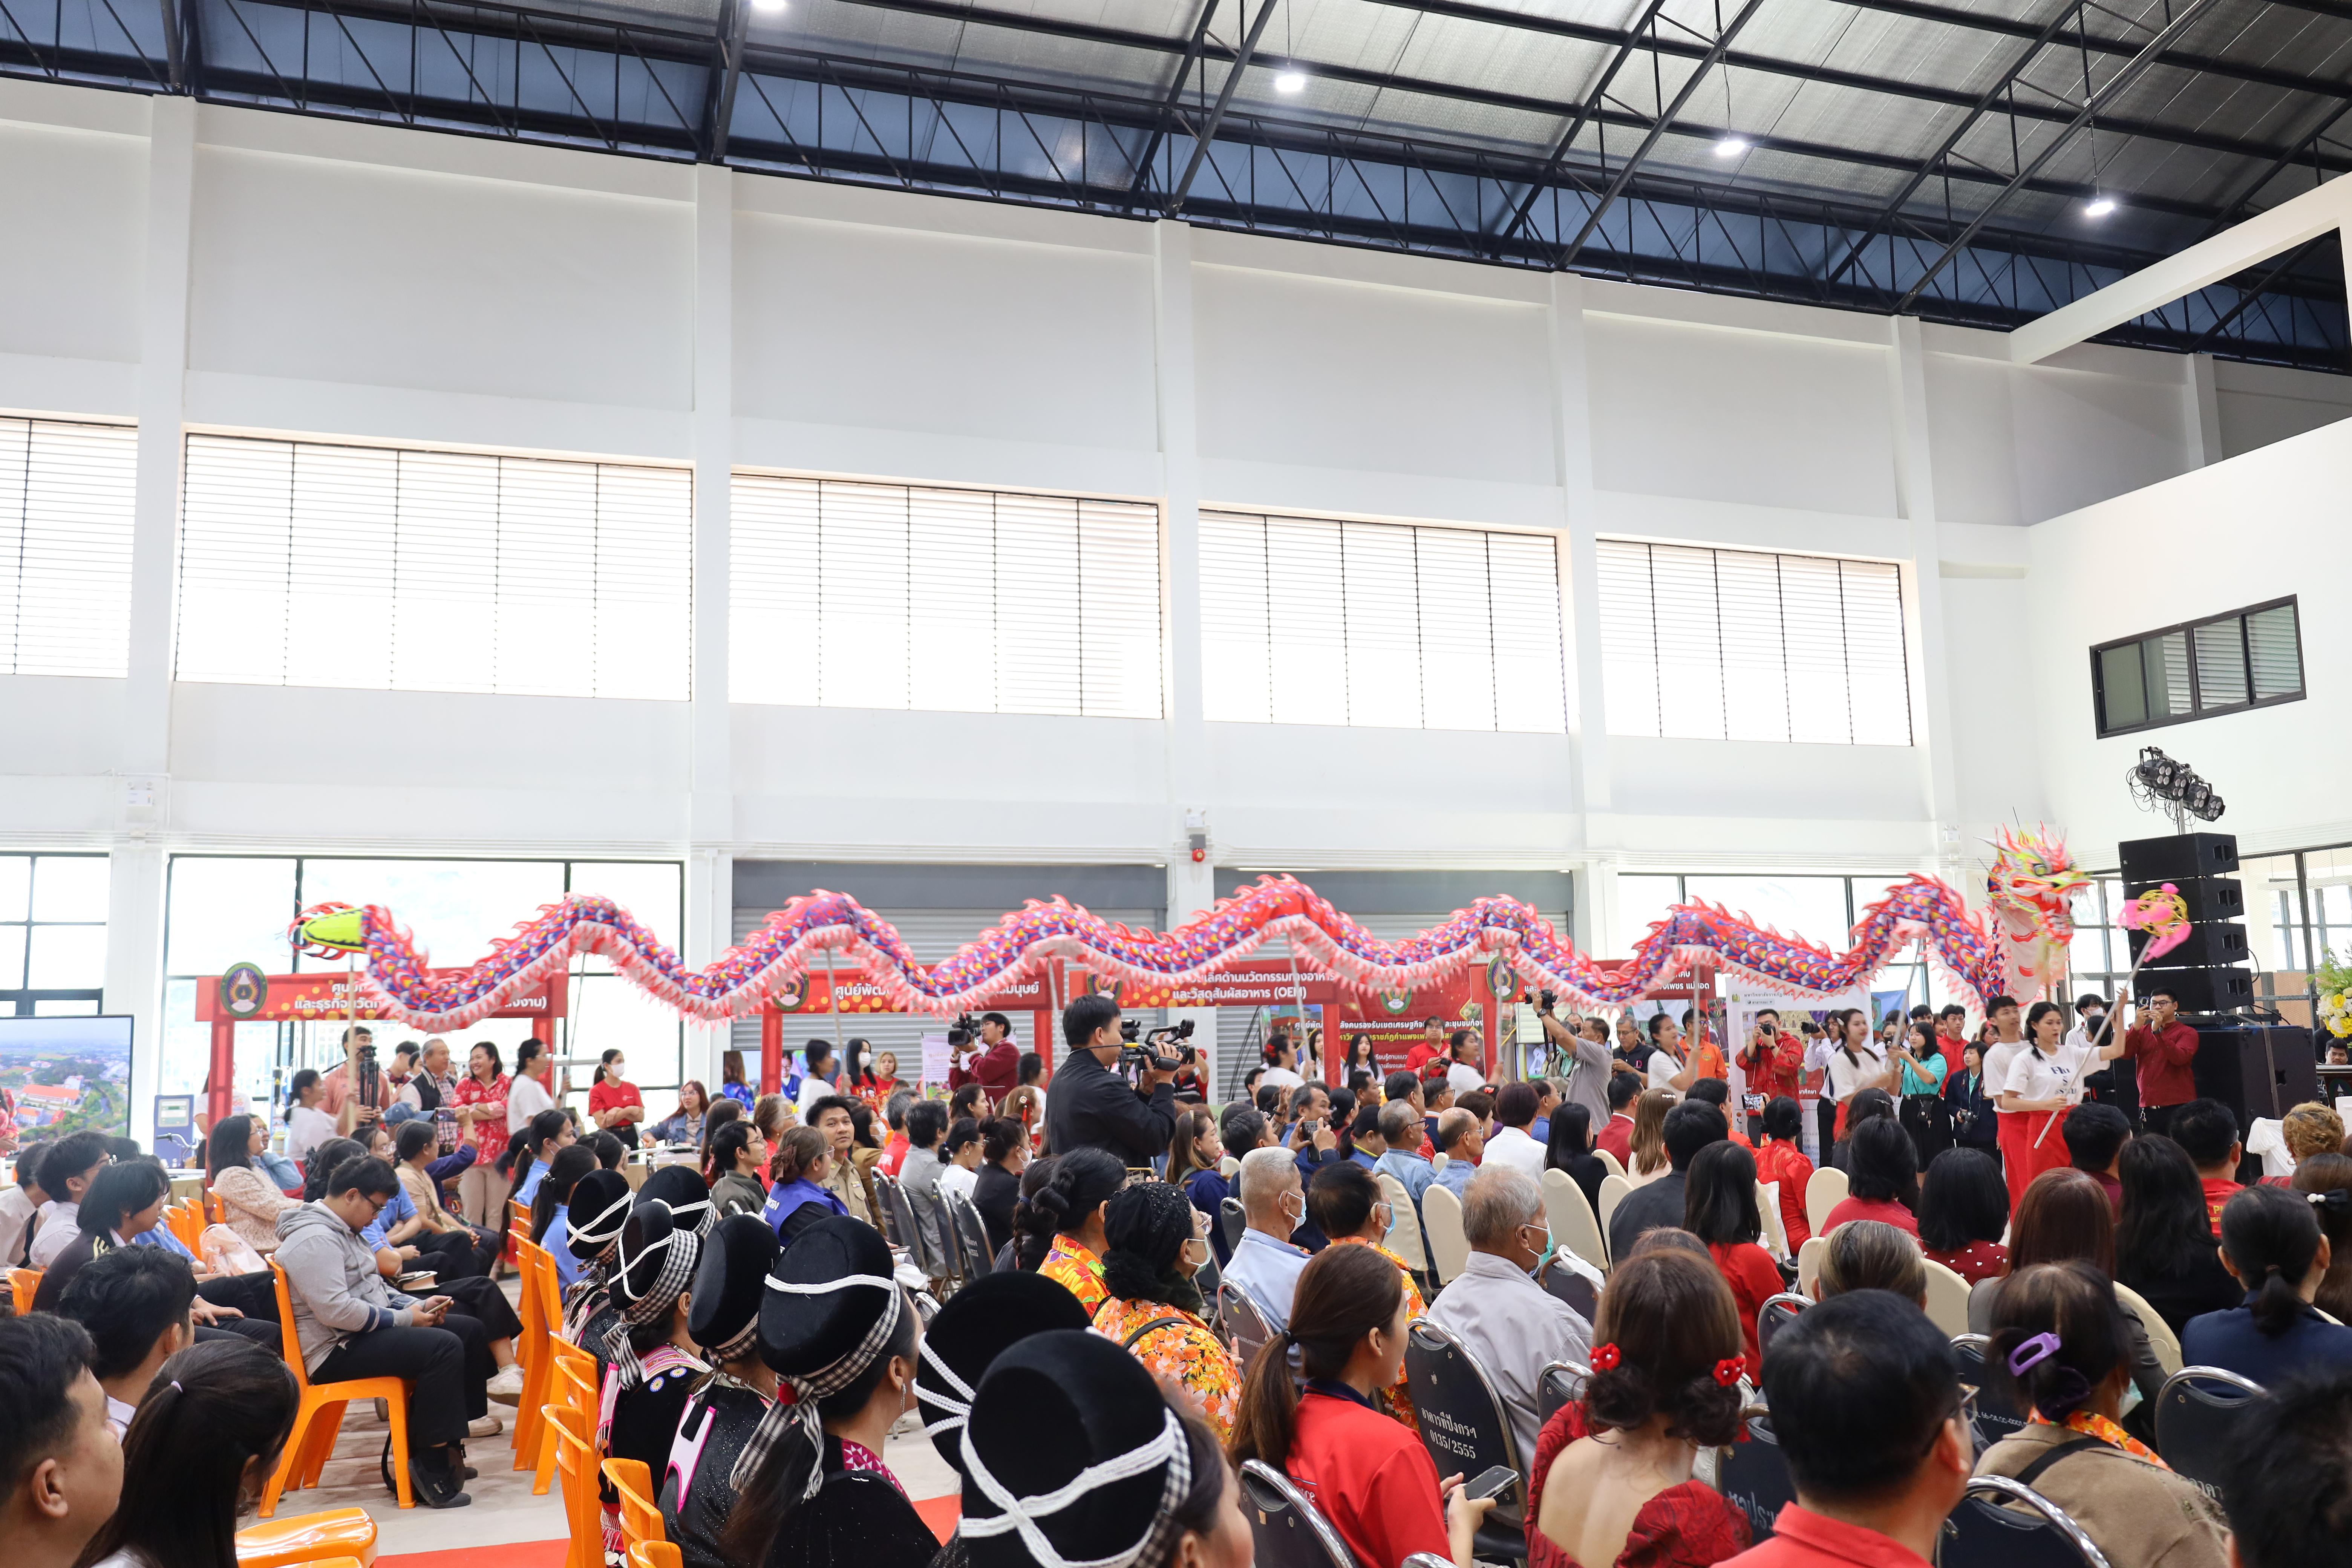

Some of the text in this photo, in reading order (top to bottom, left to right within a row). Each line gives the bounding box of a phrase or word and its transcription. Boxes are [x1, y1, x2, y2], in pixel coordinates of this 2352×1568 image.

[1172, 986, 1271, 1002] และวัสดุสัมผัสอาหาร
